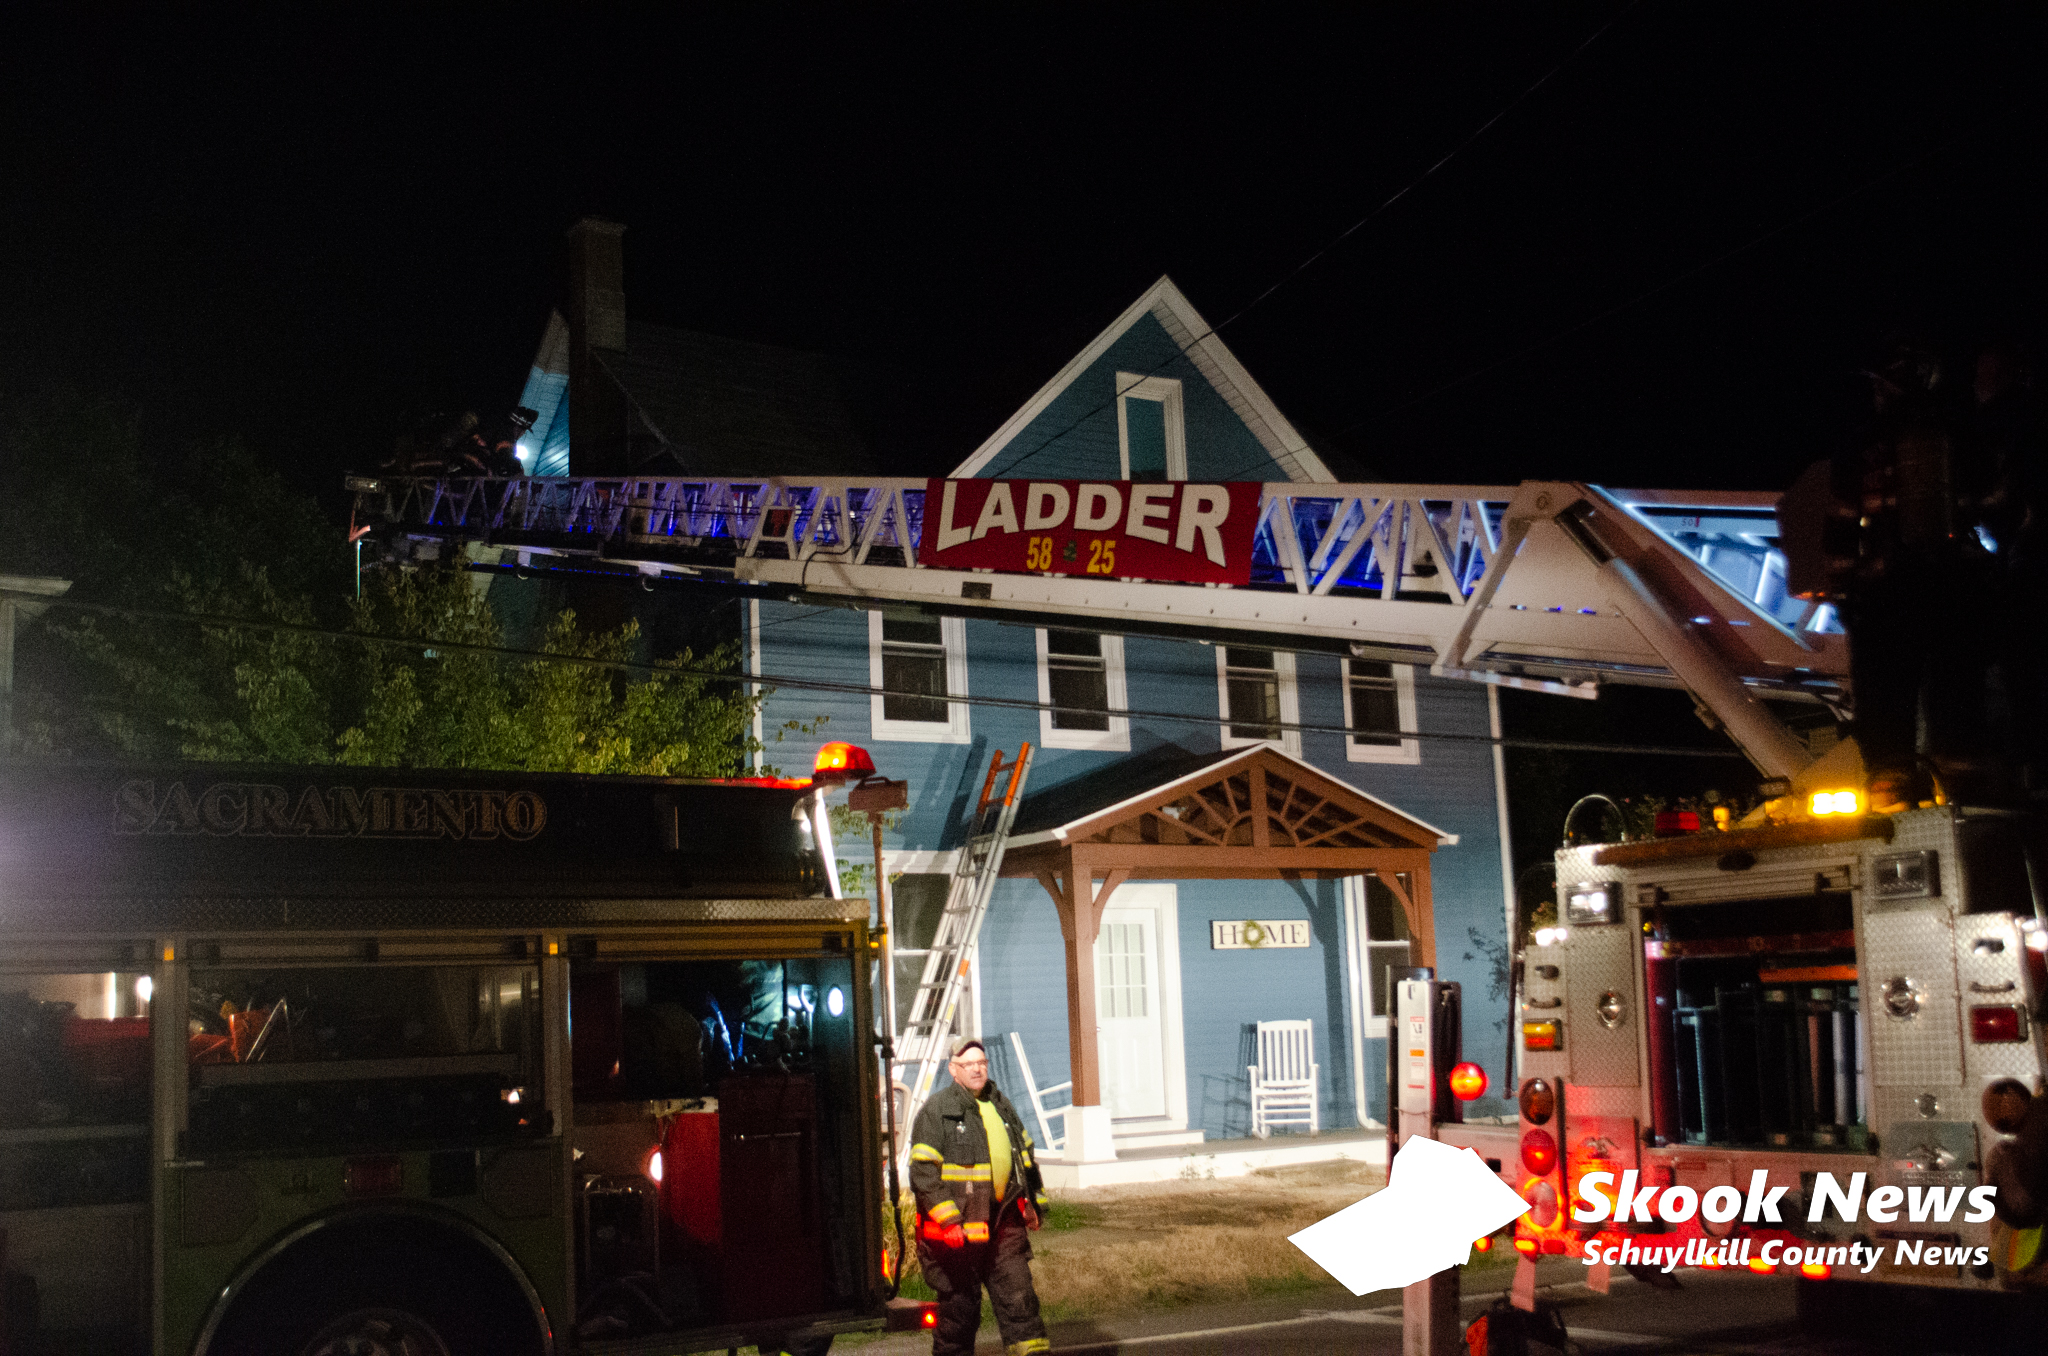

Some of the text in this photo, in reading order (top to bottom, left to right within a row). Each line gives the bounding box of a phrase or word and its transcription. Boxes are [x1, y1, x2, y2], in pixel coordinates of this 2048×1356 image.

[936, 480, 1231, 568] LADDER
[1026, 536, 1116, 575] 58 25
[113, 779, 548, 841] SACRAMENTO
[1217, 922, 1306, 946] HOME
